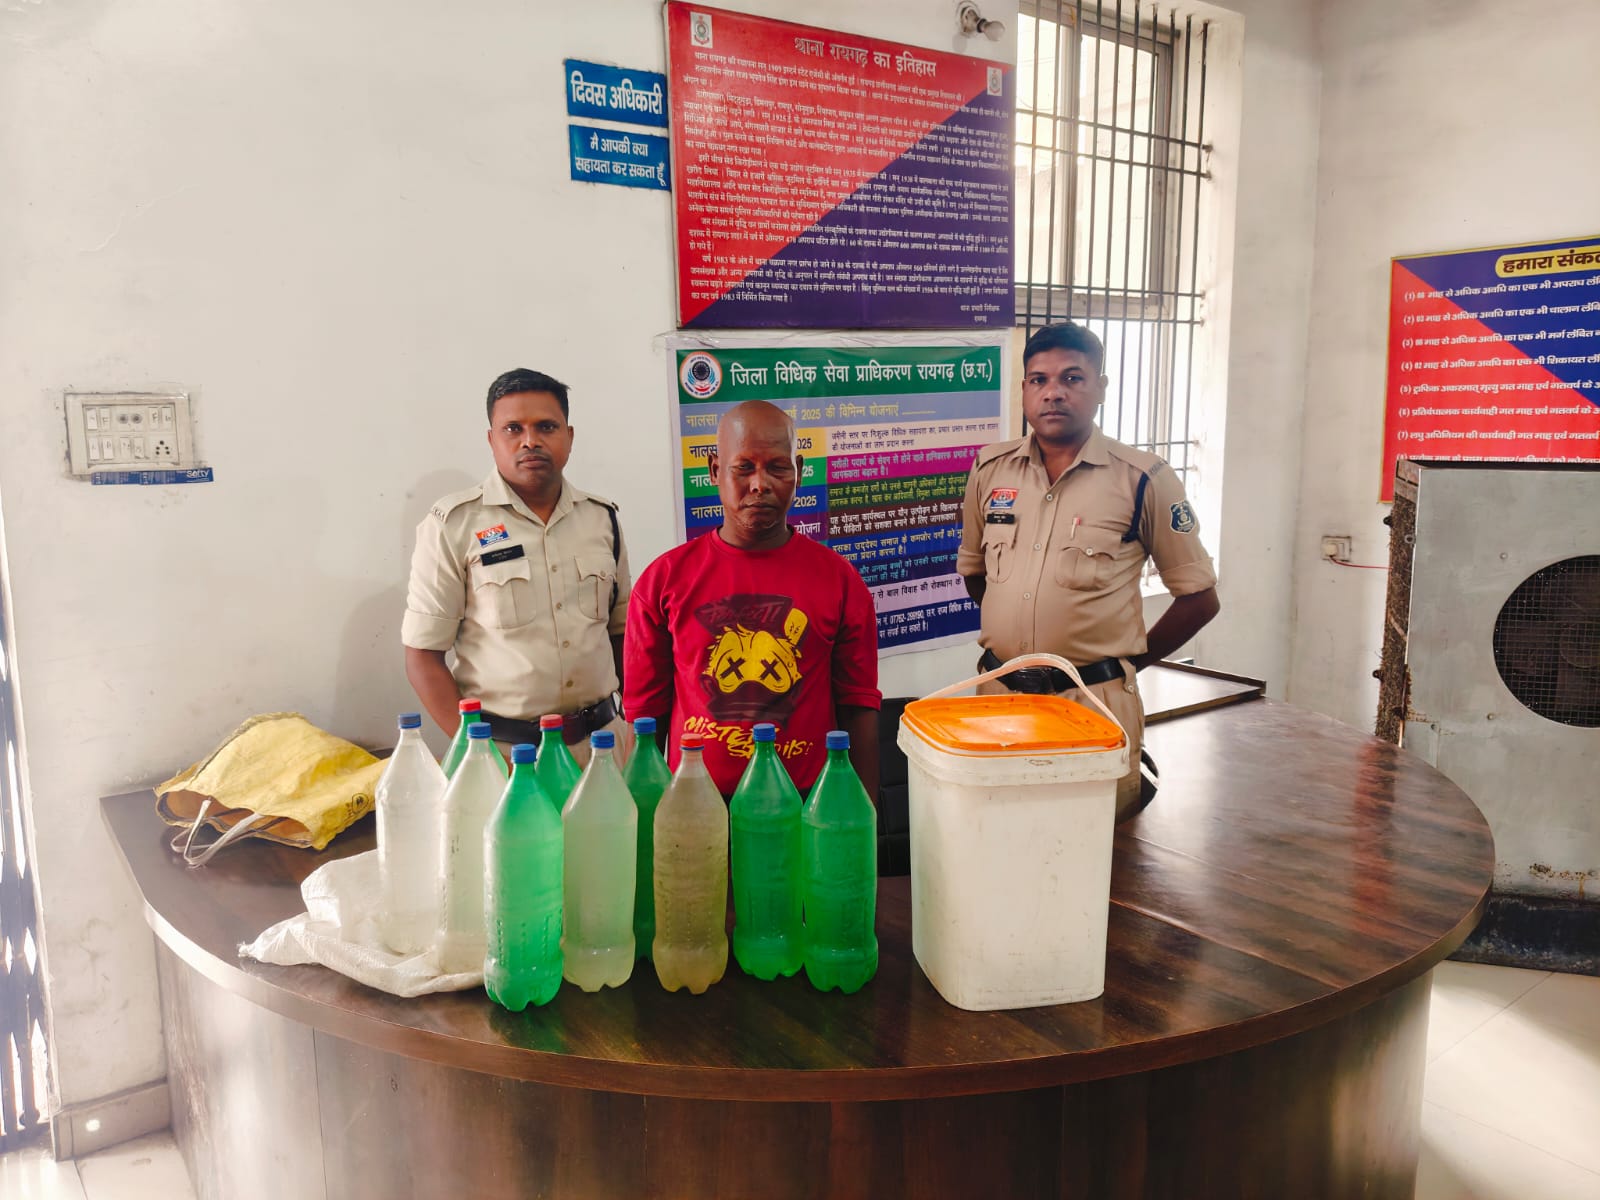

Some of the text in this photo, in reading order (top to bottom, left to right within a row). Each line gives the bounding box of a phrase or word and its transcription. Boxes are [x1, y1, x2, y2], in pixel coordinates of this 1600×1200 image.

[794, 38, 936, 76] थाना रायगढ़ का इतिहास
[571, 70, 606, 107] दिवस
[610, 78, 663, 114] अधिकारी
[601, 136, 630, 154] आपकी
[632, 143, 648, 156] क्या
[575, 157, 610, 173] सहायता
[612, 162, 626, 176] कर
[629, 164, 654, 178] सकता
[1502, 256, 1554, 273] हमारा
[1522, 283, 1538, 291] एक
[1540, 280, 1551, 288] भी
[1519, 308, 1534, 316] एक
[1537, 306, 1548, 314] भी
[1535, 330, 1546, 340] भी
[1534, 356, 1545, 364] भी
[1547, 355, 1586, 364] शिकायत
[730, 362, 768, 386] जिला
[774, 361, 817, 384] विधिक
[823, 360, 849, 383] सेवा
[855, 360, 911, 382] प्राधिकरण
[917, 364, 955, 382] रायगढ़
[961, 359, 992, 383] (छ.ग.)
[1582, 380, 1593, 388] के
[685, 414, 717, 428] नालसा
[801, 409, 821, 420] 2025
[825, 404, 835, 418] की
[1581, 405, 1592, 414] के
[1466, 430, 1478, 438] की
[794, 496, 816, 508] 2025
[842, 514, 859, 523] योजना
[932, 504, 937, 512] के
[794, 521, 822, 535] योजना
[864, 523, 872, 531] को
[910, 517, 915, 525] के
[918, 516, 927, 524] लिए
[880, 538, 898, 546] समाज
[901, 534, 907, 543] के
[947, 530, 954, 538] को
[861, 552, 876, 560] प्रदान
[879, 548, 895, 557] करना
[887, 589, 898, 597] बाल
[902, 585, 917, 595] विवाह
[920, 582, 928, 591] की
[956, 577, 961, 585] के
